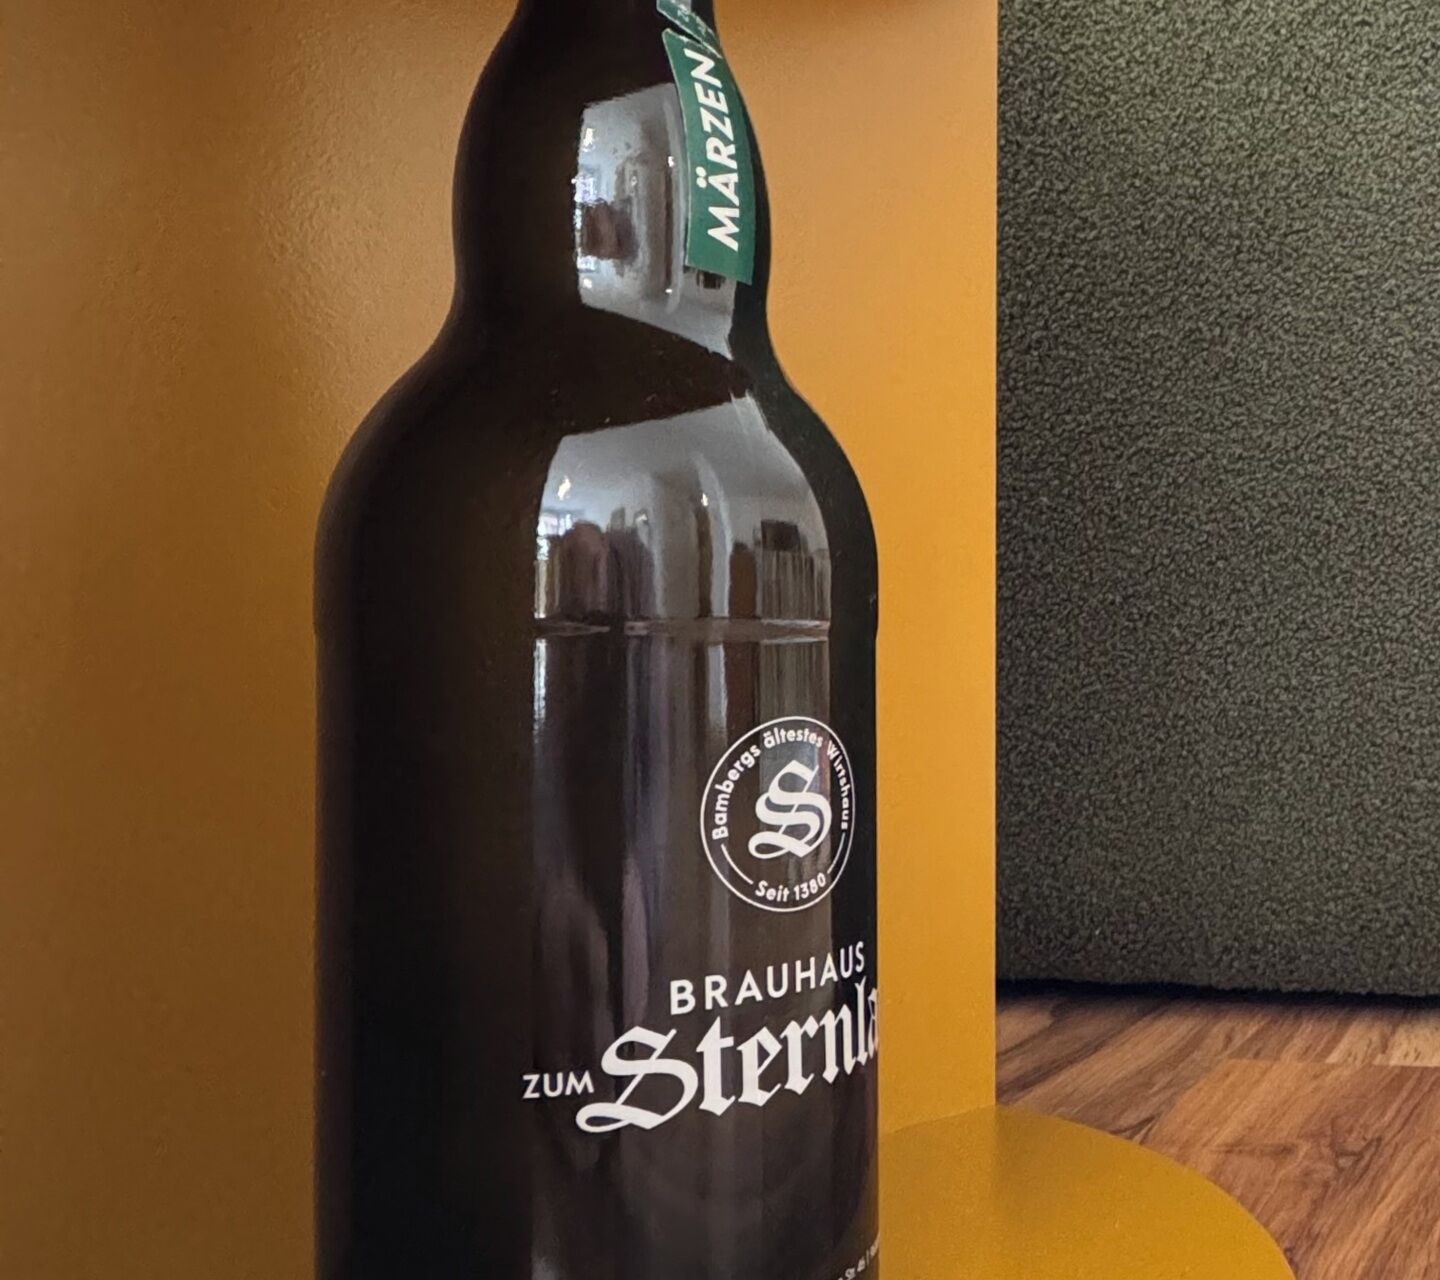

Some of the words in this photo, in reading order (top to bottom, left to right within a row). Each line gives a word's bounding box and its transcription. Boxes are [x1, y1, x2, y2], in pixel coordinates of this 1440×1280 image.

[683, 48, 741, 253] MÄRZEN
[711, 744, 762, 841] Bambergs
[763, 727, 825, 749] ältestes
[826, 739, 851, 830] Wirtshaus
[747, 759, 833, 860] S
[755, 879, 790, 903] Seit
[793, 871, 827, 901] 1380
[669, 940, 865, 1016] BRAUHAUS
[522, 1070, 595, 1100] ZUM
